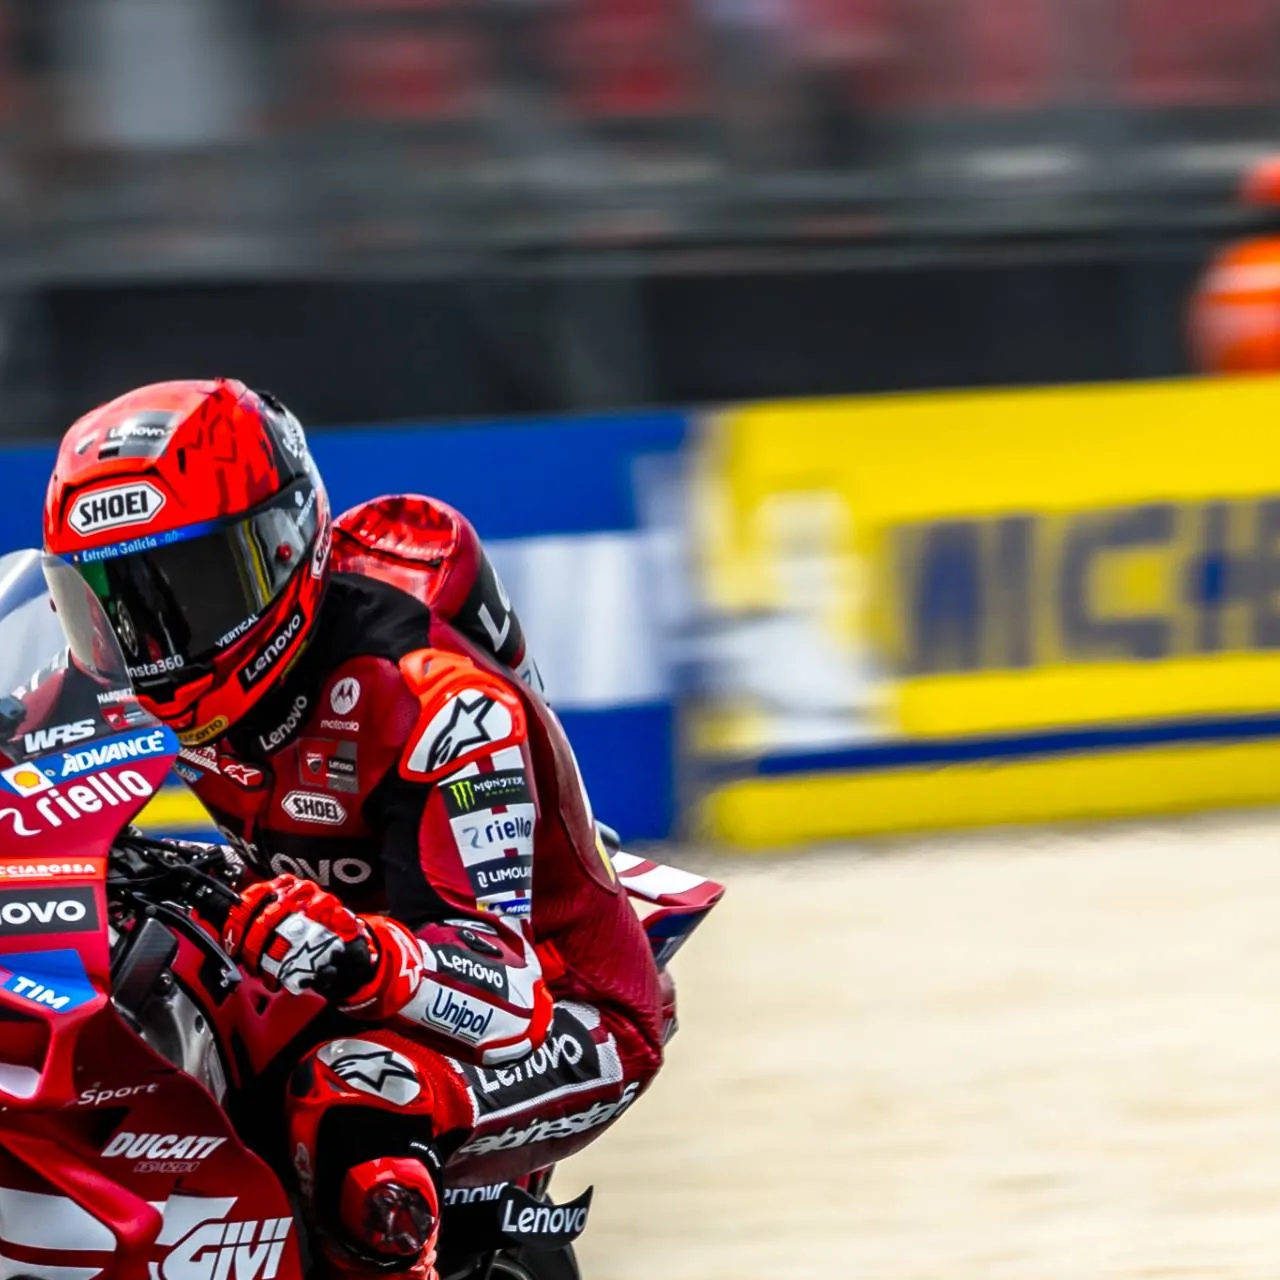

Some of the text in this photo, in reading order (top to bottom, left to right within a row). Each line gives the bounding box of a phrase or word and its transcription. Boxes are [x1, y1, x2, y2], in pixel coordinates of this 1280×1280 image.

[78, 489, 148, 526] SHOEI
[82, 546, 118, 562] Estrella
[120, 537, 157, 554] Galicia
[215, 613, 259, 648] VERTICAL
[244, 613, 301, 682] Lenovo
[24, 718, 95, 753] WRS
[259, 695, 308, 750] Lenovo
[320, 719, 359, 732] motorola
[61, 731, 165, 776] ADVANCE
[36, 770, 153, 827] riello
[293, 797, 339, 820] SHOEI
[485, 816, 532, 843] riello
[436, 949, 504, 989] Lenovo
[11, 976, 71, 1010] TIM
[431, 986, 494, 1036] Unipol
[77, 1081, 159, 1106] Sport
[100, 1132, 229, 1160] DUCATI
